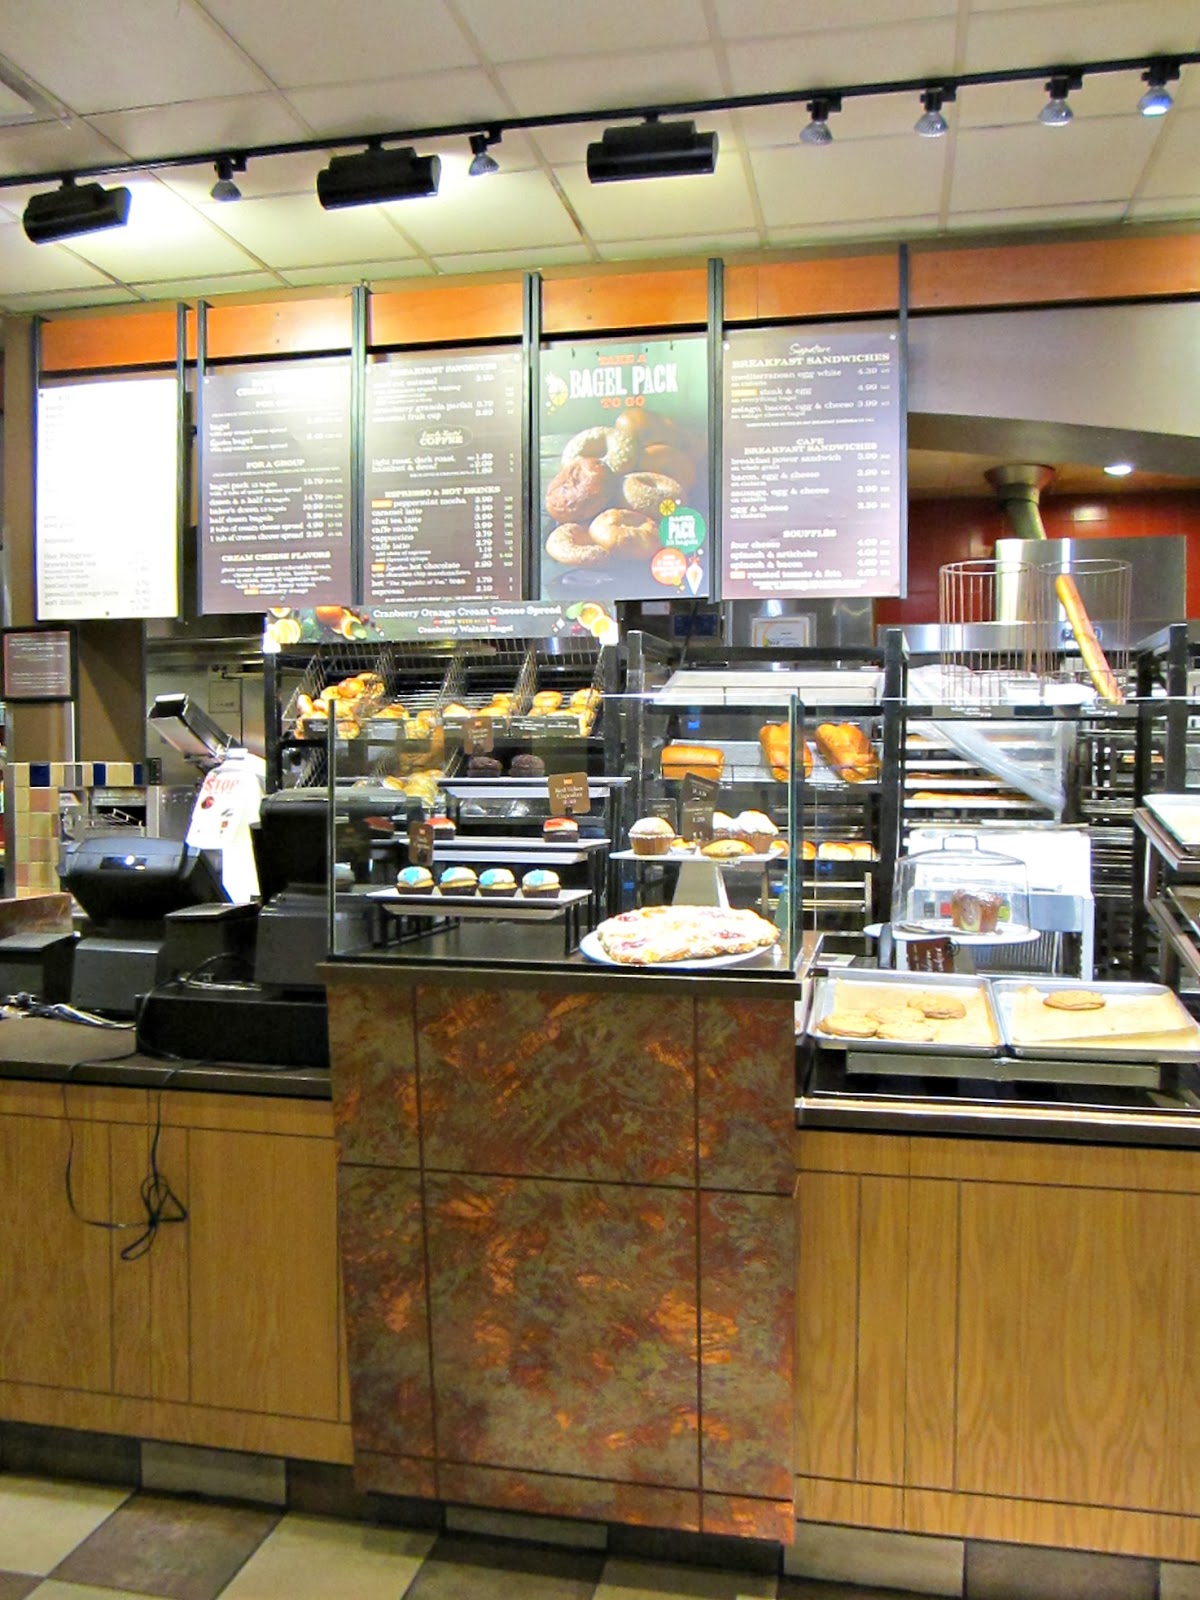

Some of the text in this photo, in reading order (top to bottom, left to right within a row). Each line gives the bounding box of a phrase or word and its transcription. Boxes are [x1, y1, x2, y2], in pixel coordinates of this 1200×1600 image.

[789, 343, 831, 356] Signature
[637, 354, 646, 363] A
[732, 353, 890, 369] BREAKFAST SANDWICHES
[569, 363, 678, 399] BAGEL PACK
[731, 372, 795, 381] mediterranean
[798, 371, 814, 380] egg
[759, 388, 782, 396] steak
[795, 388, 812, 396] egg
[601, 396, 645, 409] TO GO
[795, 403, 812, 411] egg
[824, 401, 854, 409] cheese
[420, 435, 463, 446] COFFEE
[744, 442, 877, 455] BREAKFAST SANDWICHES
[246, 461, 264, 469] FOR
[274, 459, 305, 468] GROUP
[773, 456, 798, 464] power
[801, 454, 841, 462] sandwich
[762, 472, 778, 481] egg
[209, 483, 230, 491] bagel
[232, 482, 249, 490] pack
[385, 489, 431, 498] ESPRESSO
[464, 486, 500, 494] DRINKS
[771, 489, 788, 497] egg
[247, 496, 264, 504] half
[394, 499, 438, 508] peppermint
[730, 506, 748, 514] egg
[209, 516, 225, 524] half
[282, 522, 303, 532] spread
[668, 521, 695, 540] PACK
[280, 532, 303, 541] spread
[751, 541, 781, 549] cheese
[222, 551, 330, 562] CREAM CHEESE FLAVORS
[730, 551, 765, 560] spinach
[777, 550, 818, 558] artichoke
[730, 562, 765, 570] spinach
[371, 579, 384, 587] hot
[371, 588, 405, 596] espresso
[373, 605, 561, 619] Cranberry Orange Cream Cheese Spread
[418, 626, 458, 634] Cranberry
[490, 624, 513, 634] Bagel
[205, 777, 239, 792] STOP
